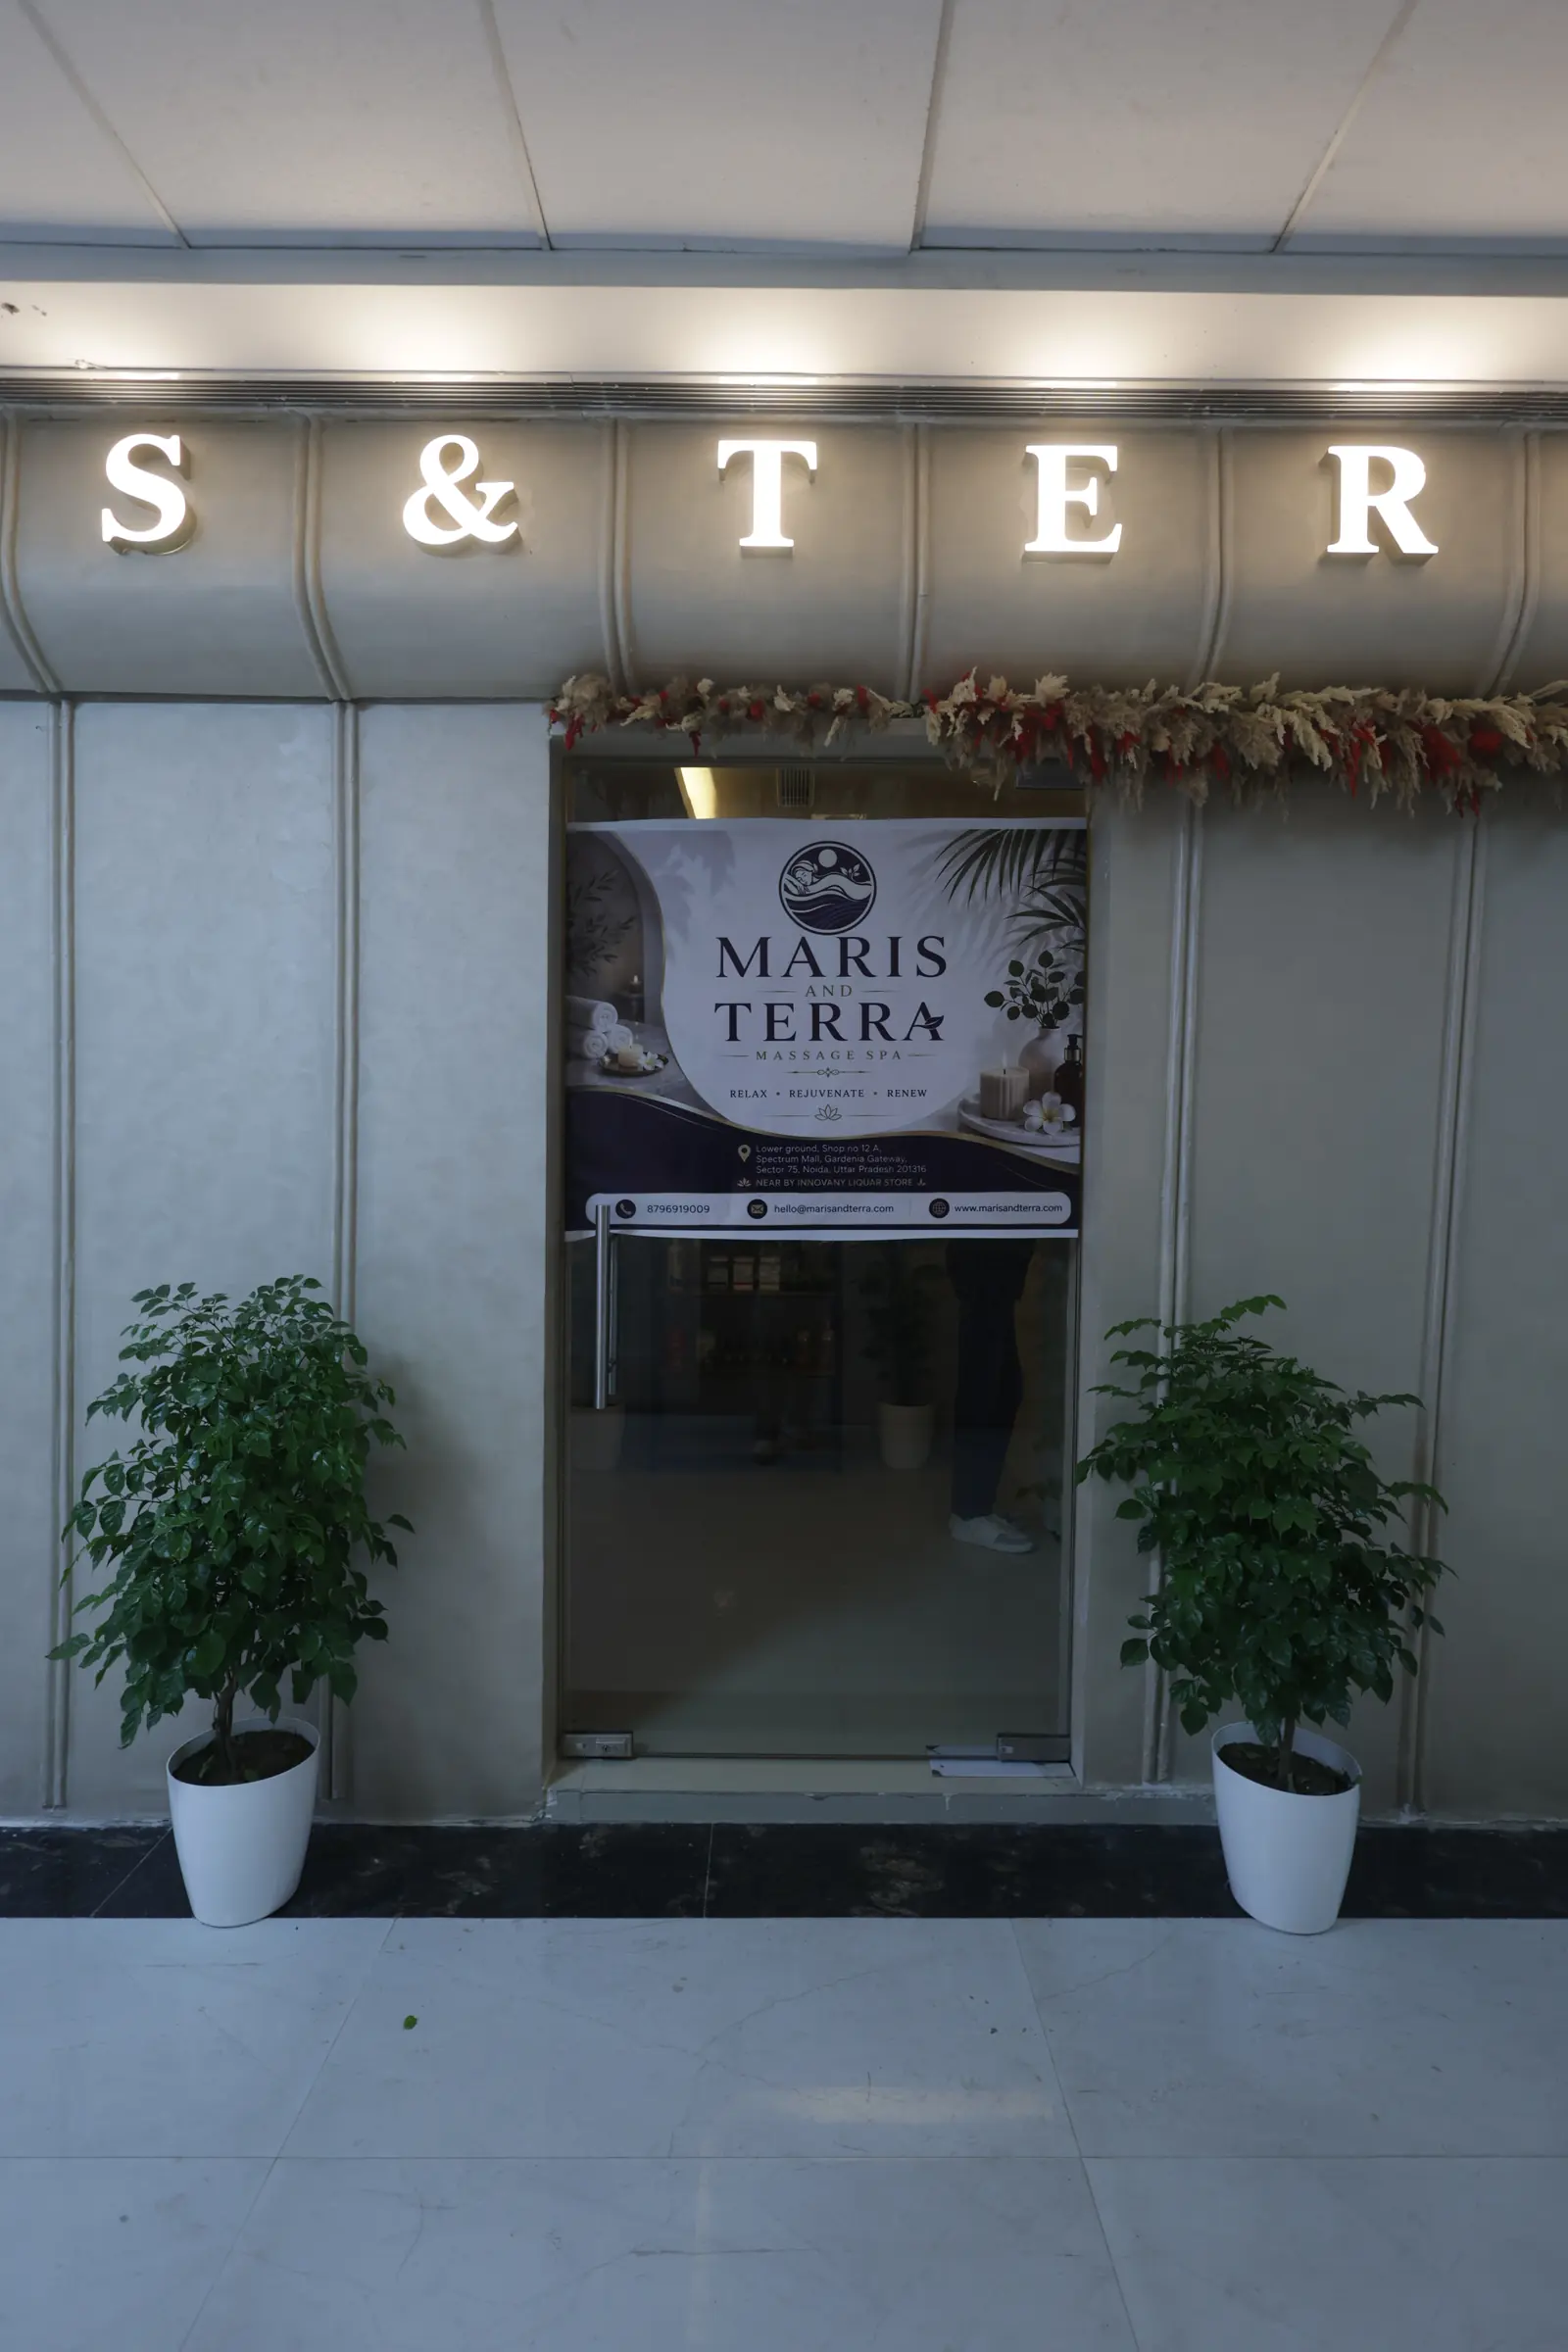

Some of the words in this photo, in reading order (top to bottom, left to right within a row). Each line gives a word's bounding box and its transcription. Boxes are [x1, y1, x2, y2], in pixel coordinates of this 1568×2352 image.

[401, 433, 519, 546] &
[715, 935, 948, 979] MARIS
[804, 984, 854, 998] AND
[713, 1001, 945, 1043] TERRA
[755, 1050, 856, 1060] MASSAGE
[865, 1050, 903, 1060] SPA
[729, 1088, 768, 1099] RELAX
[788, 1088, 865, 1099] REJUVENATE
[886, 1088, 928, 1099] RENEW
[756, 1144, 784, 1152] Lower
[821, 1144, 845, 1154] Shop
[756, 1155, 799, 1165] Spectrum
[801, 1155, 822, 1164] Mall,
[756, 1165, 785, 1174] Sector
[646, 1203, 710, 1214] 8796919009
[773, 1202, 895, 1214] hello@marisandterra.com
[954, 1202, 1063, 1213] www.marisandterra.com
